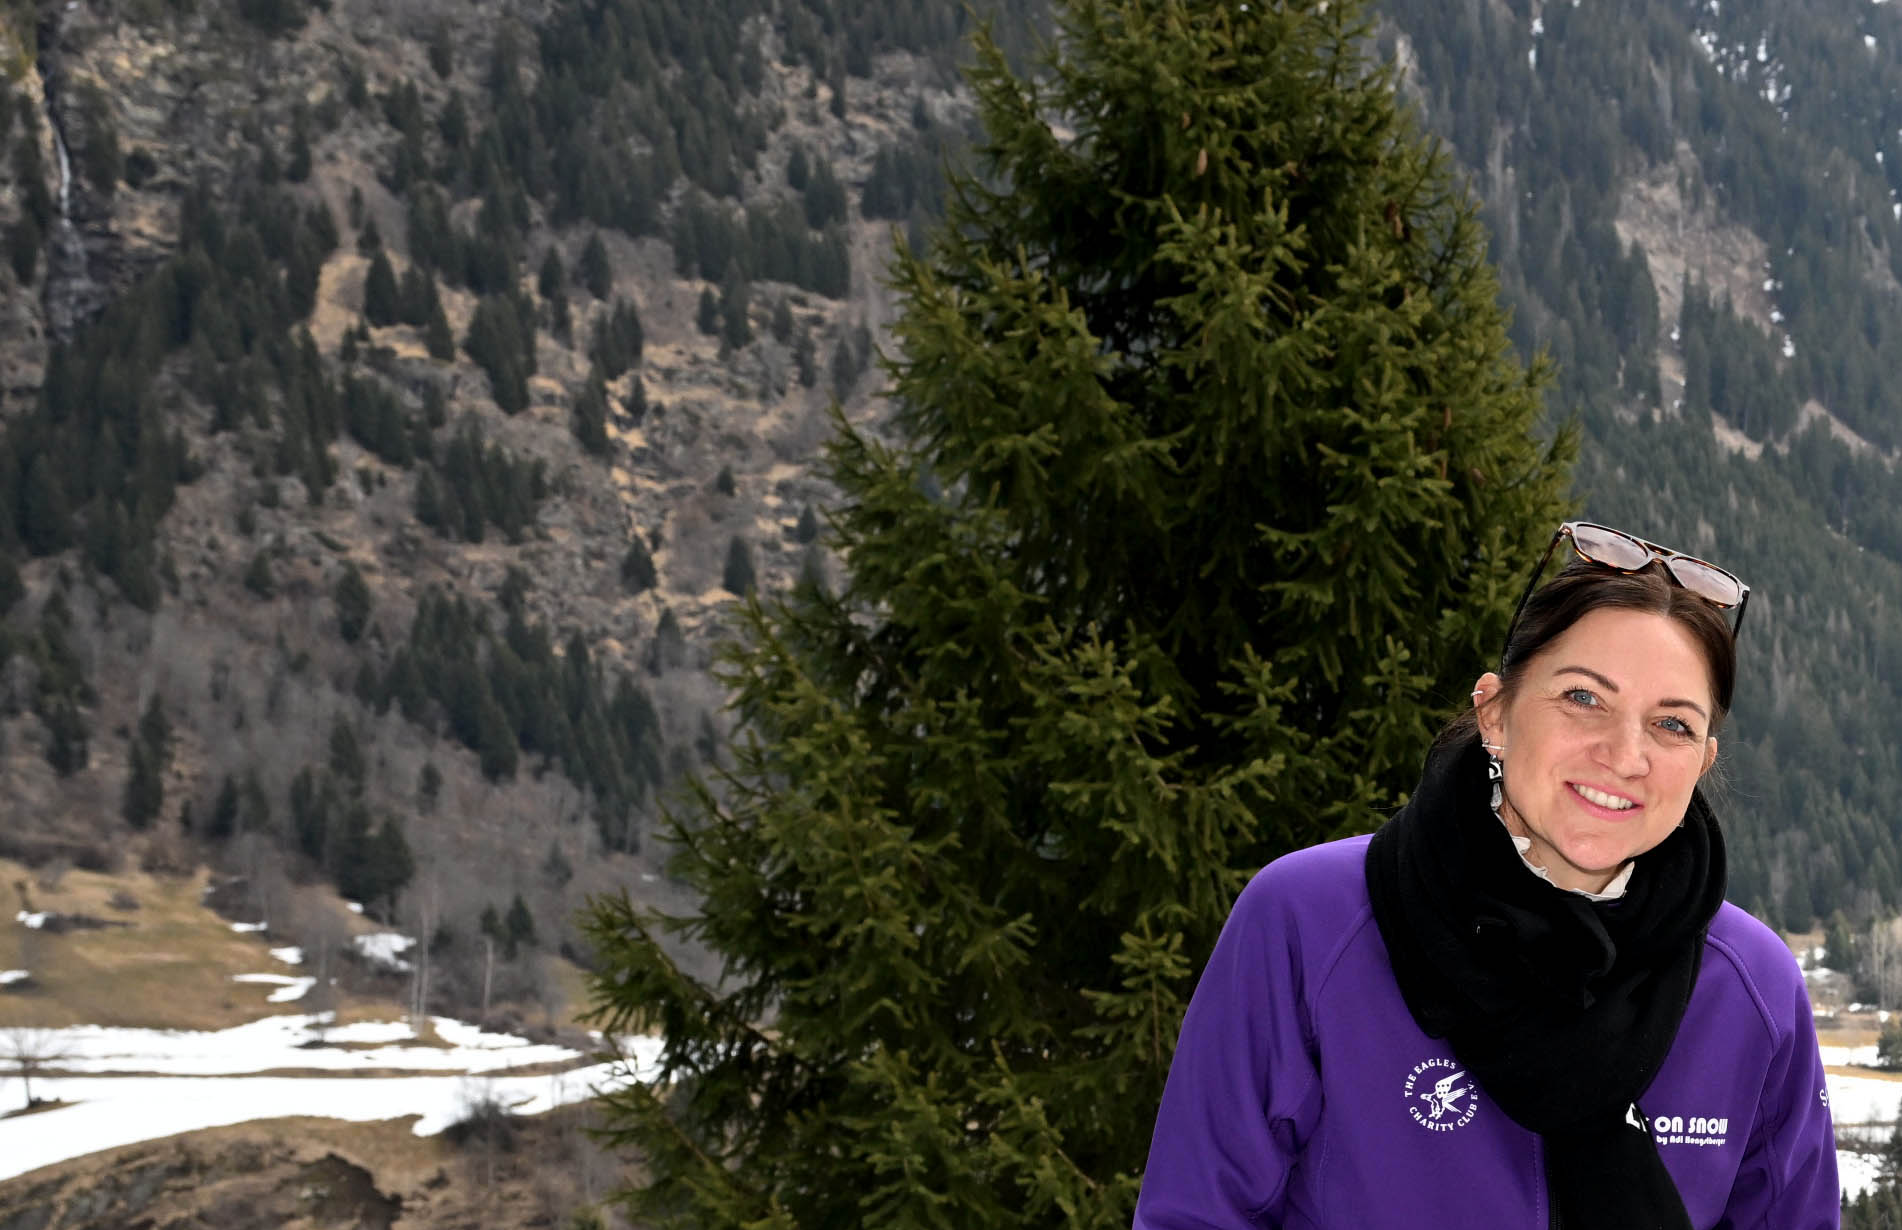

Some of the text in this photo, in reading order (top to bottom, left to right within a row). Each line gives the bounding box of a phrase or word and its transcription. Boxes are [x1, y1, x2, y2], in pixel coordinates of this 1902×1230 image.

[1404, 1058, 1456, 1098] THE EAGLES
[1409, 1106, 1454, 1132] CHARITY
[1457, 1103, 1478, 1127] CLUB
[1654, 1116, 1683, 1133] ON
[1688, 1117, 1728, 1135] SNOW
[1656, 1135, 1667, 1145] by
[1669, 1136, 1683, 1144] Adi
